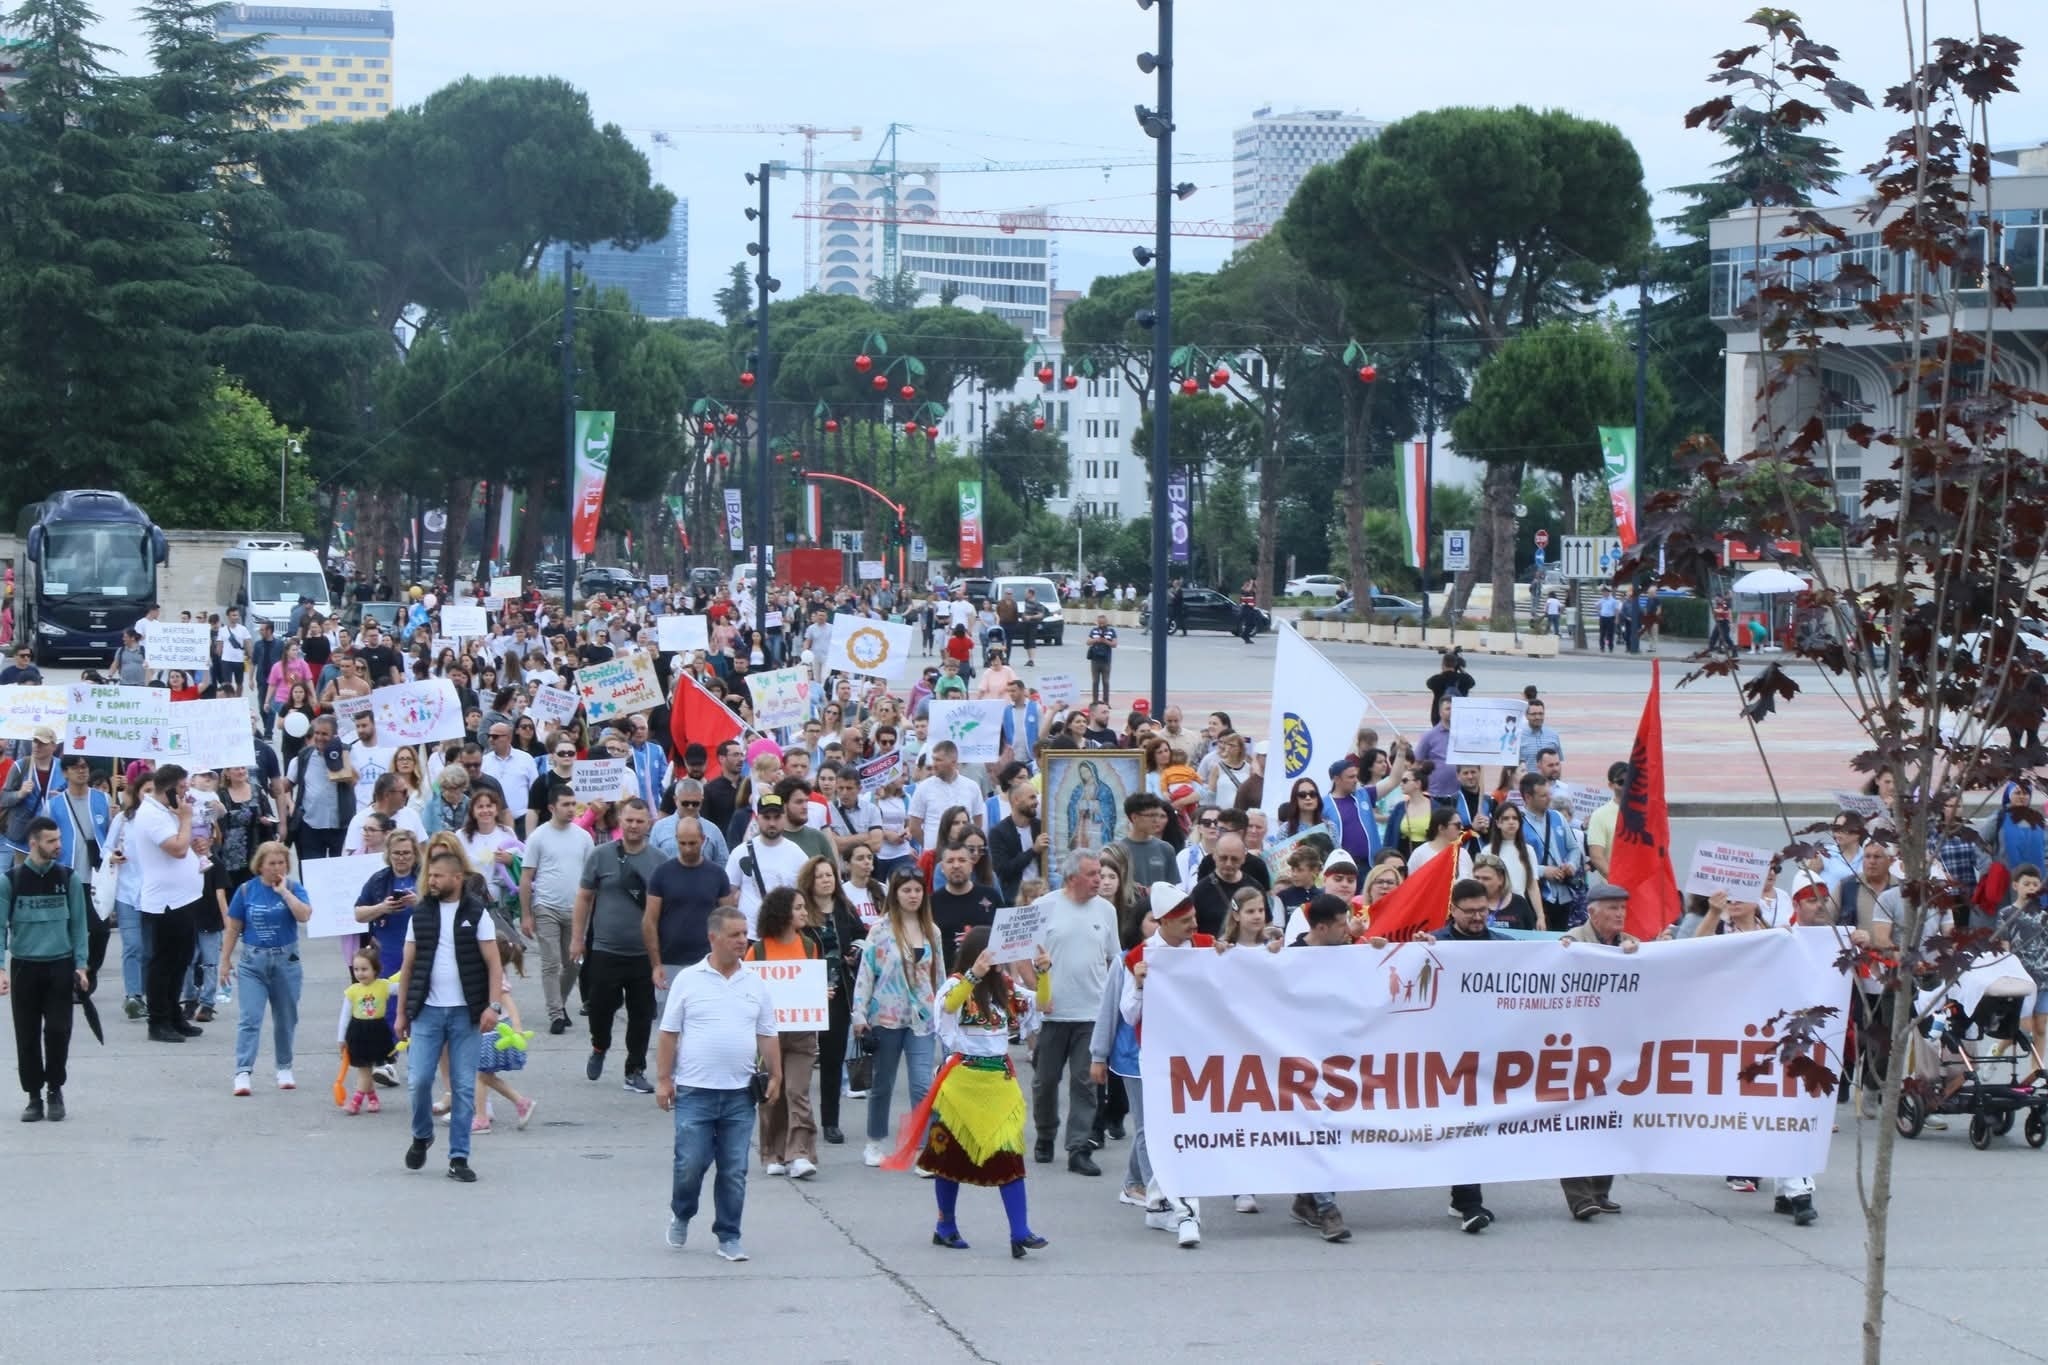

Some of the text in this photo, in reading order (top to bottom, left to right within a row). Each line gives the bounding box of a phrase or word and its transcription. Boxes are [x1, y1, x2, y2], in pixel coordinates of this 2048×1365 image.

[752, 965, 802, 980] TOP
[1461, 972, 1640, 994] KOALICIONI SHQIPTAR
[1497, 997, 1516, 1010] PRO
[1519, 997, 1563, 1010] FAMILJES
[1169, 1051, 1480, 1114] MARSHIM
[1493, 1032, 1612, 1104] PËR
[1174, 1129, 1245, 1153] ÇMOJMË
[1250, 1130, 1341, 1147] FAMILJEN!
[1351, 1124, 1433, 1144] MBROJMË
[1437, 1121, 1488, 1141] JETËN!
[1498, 1113, 1561, 1136] RUAJMË
[1566, 1111, 1623, 1131] LIRINË!
[1633, 1111, 1747, 1130] KULTIVOJMË
